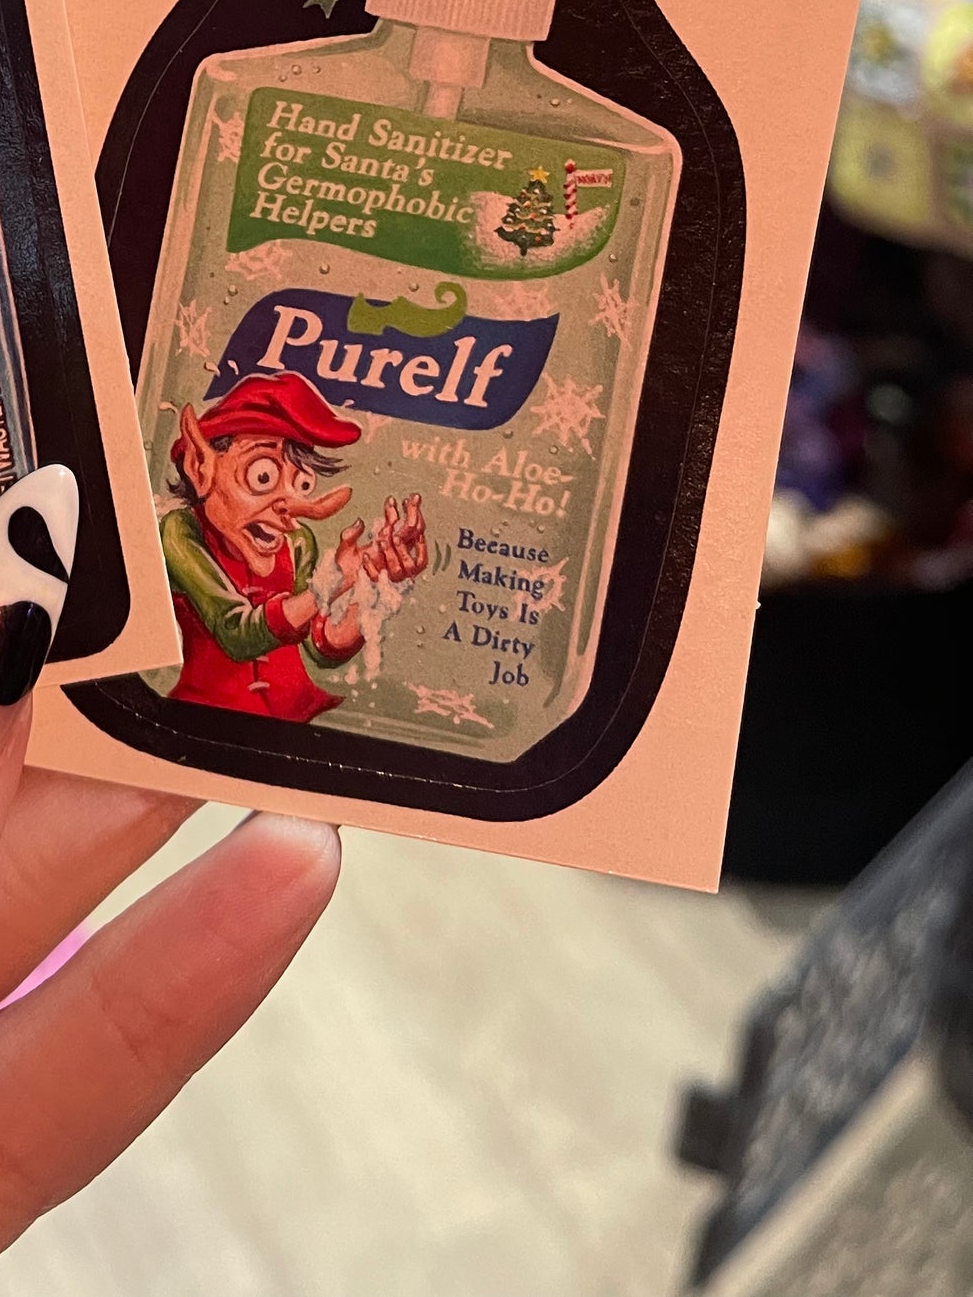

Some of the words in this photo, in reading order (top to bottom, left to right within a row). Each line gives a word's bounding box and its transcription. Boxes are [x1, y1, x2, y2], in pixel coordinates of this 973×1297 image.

[259, 131, 312, 164] for
[321, 141, 435, 187] Santa's
[266, 100, 362, 141] Hand
[368, 118, 513, 170] Sanitizer
[249, 190, 378, 238] Helpers
[257, 162, 474, 224] Germophobic
[257, 304, 513, 408] Purelf
[400, 437, 471, 469] with
[481, 447, 574, 485] Aloe-
[438, 467, 572, 518] Ho-Ho!
[457, 527, 549, 563] Because
[457, 560, 545, 601] Making
[456, 590, 509, 620] Toys
[517, 602, 540, 625] Is
[442, 620, 462, 643] A
[471, 626, 536, 660] Dirty
[488, 660, 530, 688] Job
